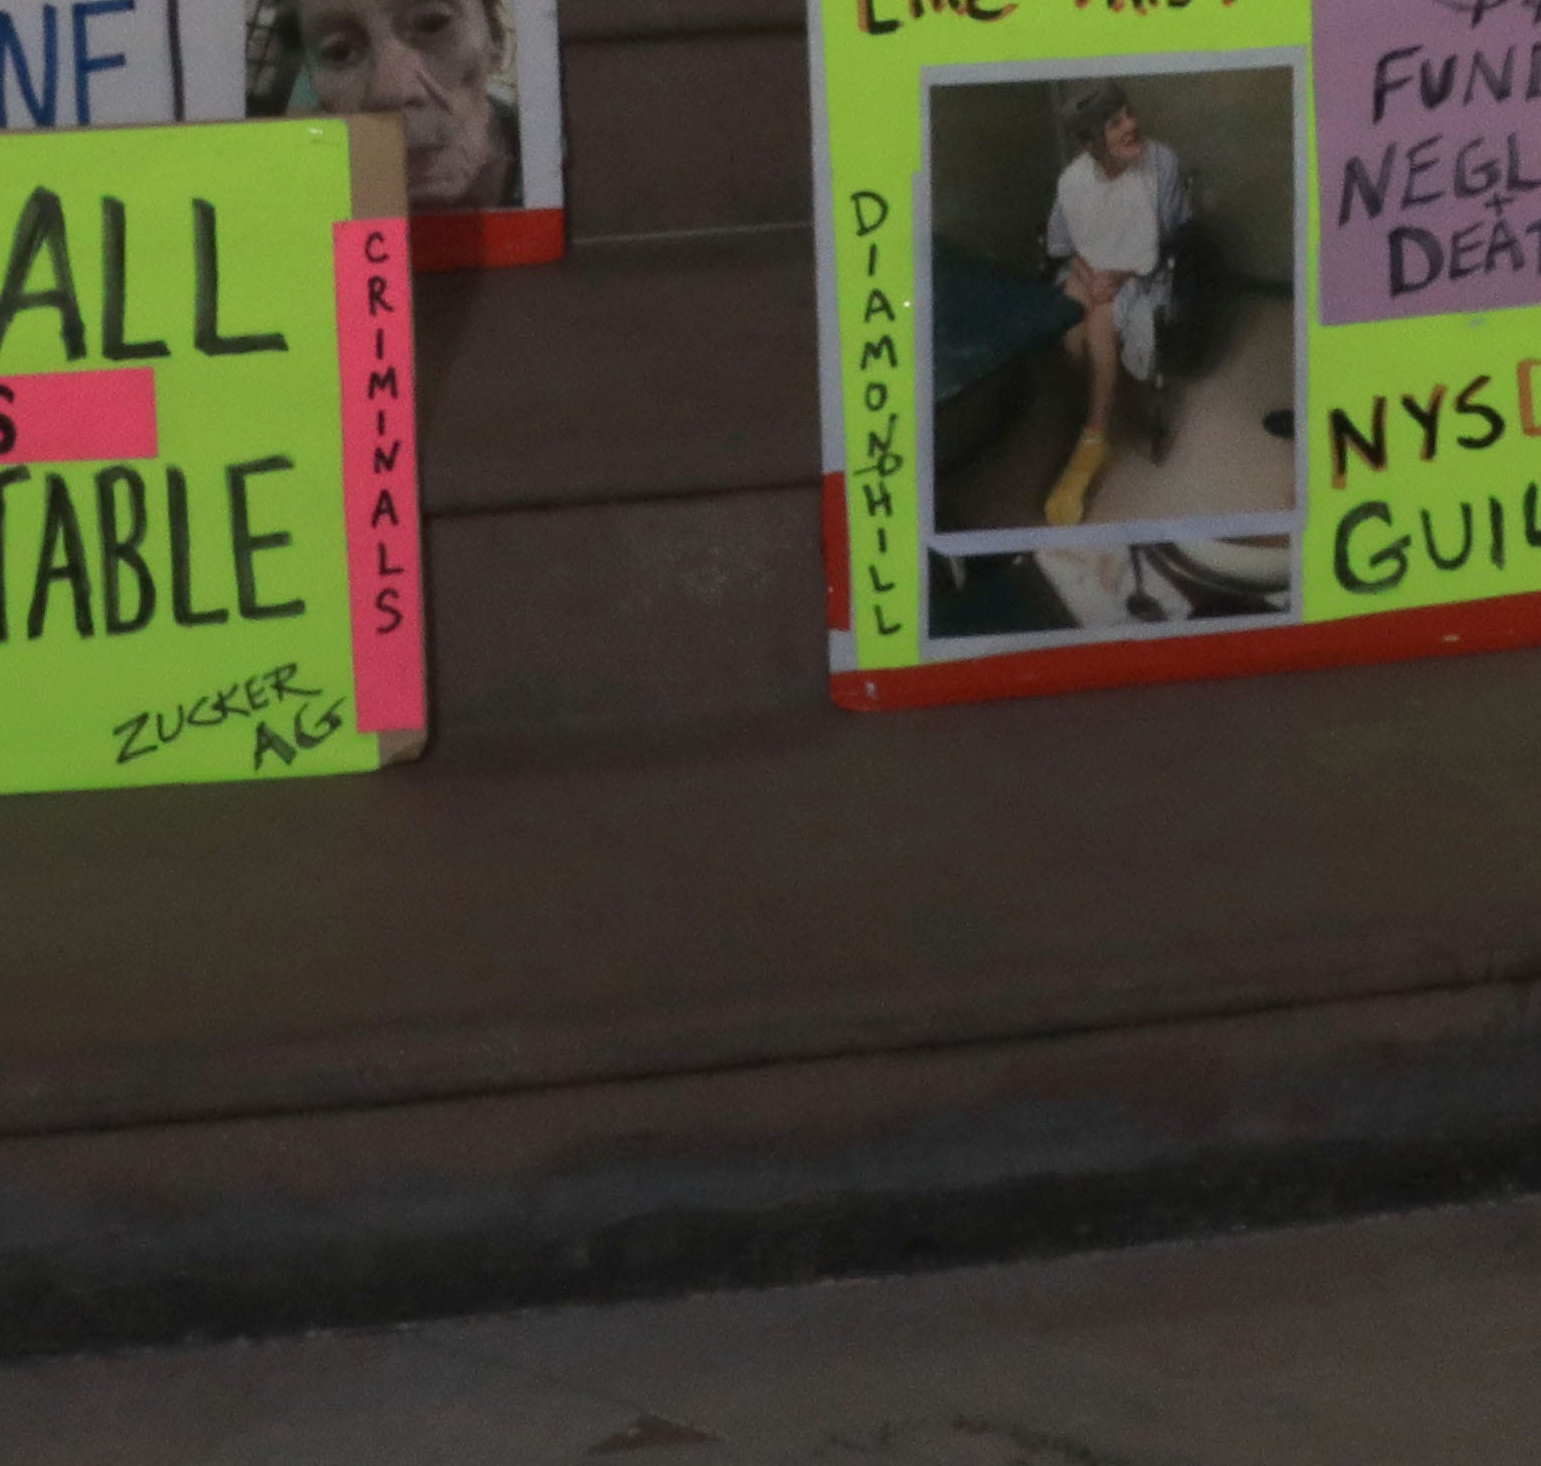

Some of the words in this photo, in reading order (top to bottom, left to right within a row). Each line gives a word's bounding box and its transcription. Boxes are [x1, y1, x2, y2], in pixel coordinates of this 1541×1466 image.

[358, 229, 407, 638] CRIMINALS
[112, 662, 322, 764] ZUCKER
[251, 694, 349, 770] AG
